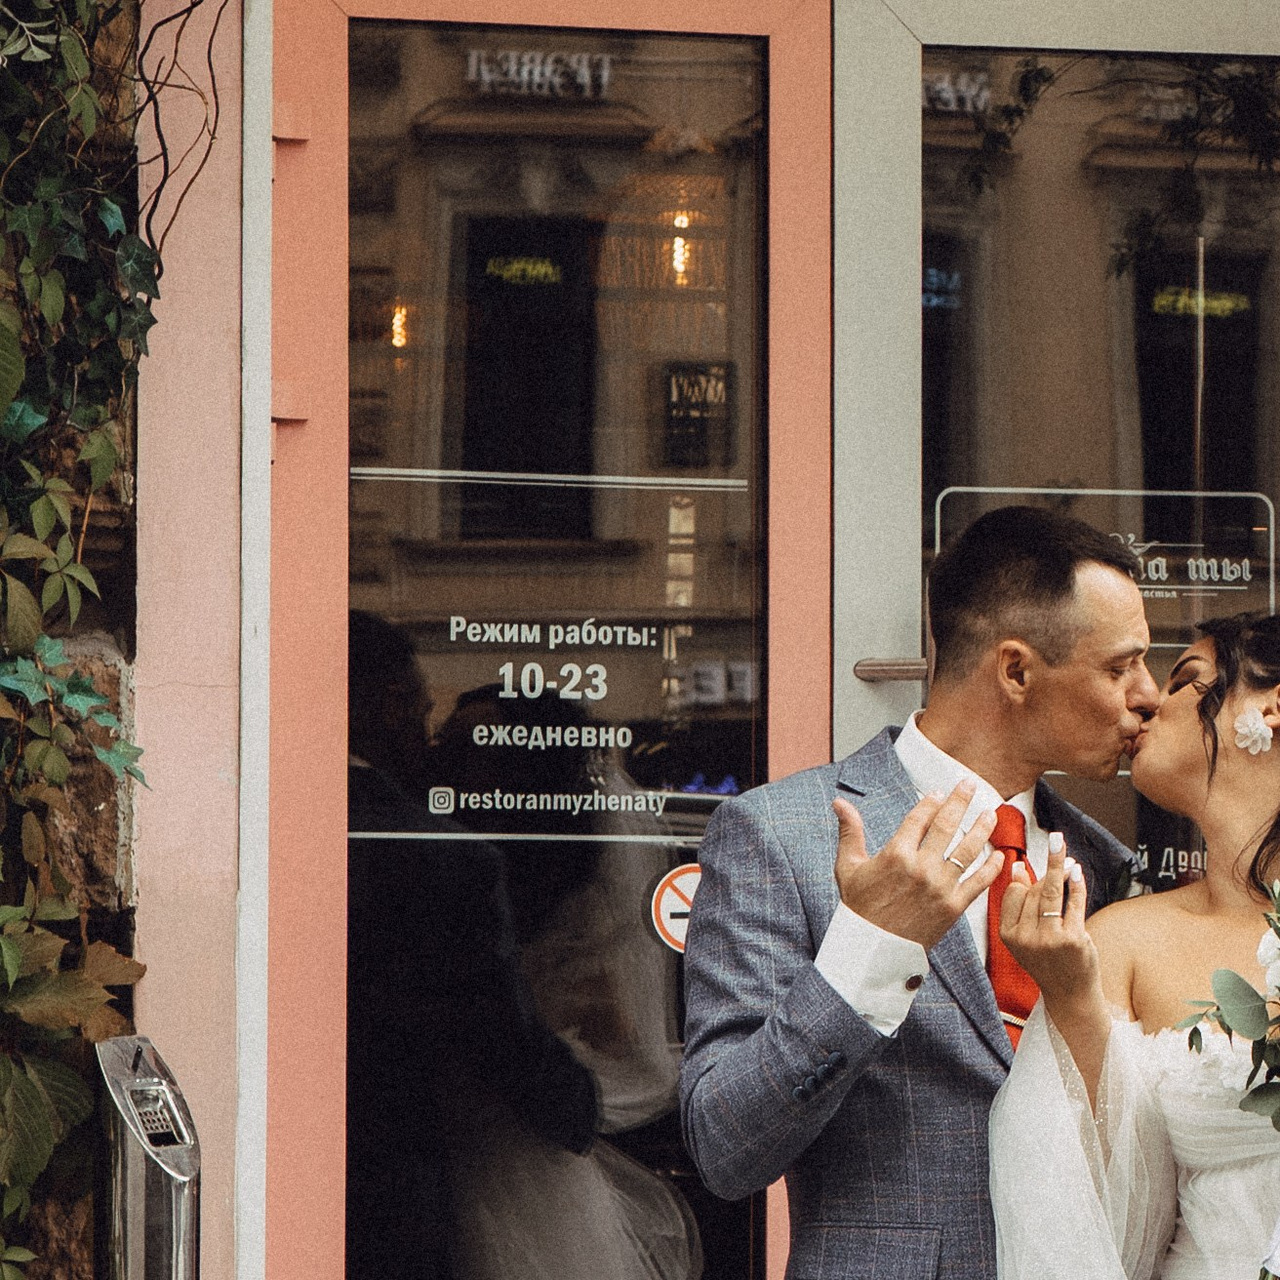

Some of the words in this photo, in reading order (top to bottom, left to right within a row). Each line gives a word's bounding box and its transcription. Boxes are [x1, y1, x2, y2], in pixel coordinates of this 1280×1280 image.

[449, 615, 542, 644] Режим
[549, 617, 658, 650] работы:
[498, 661, 609, 701] 10-23
[472, 723, 633, 751] ежедневно
[459, 788, 667, 817] restoranmyzhenaty
[1158, 846, 1208, 881] Дво
